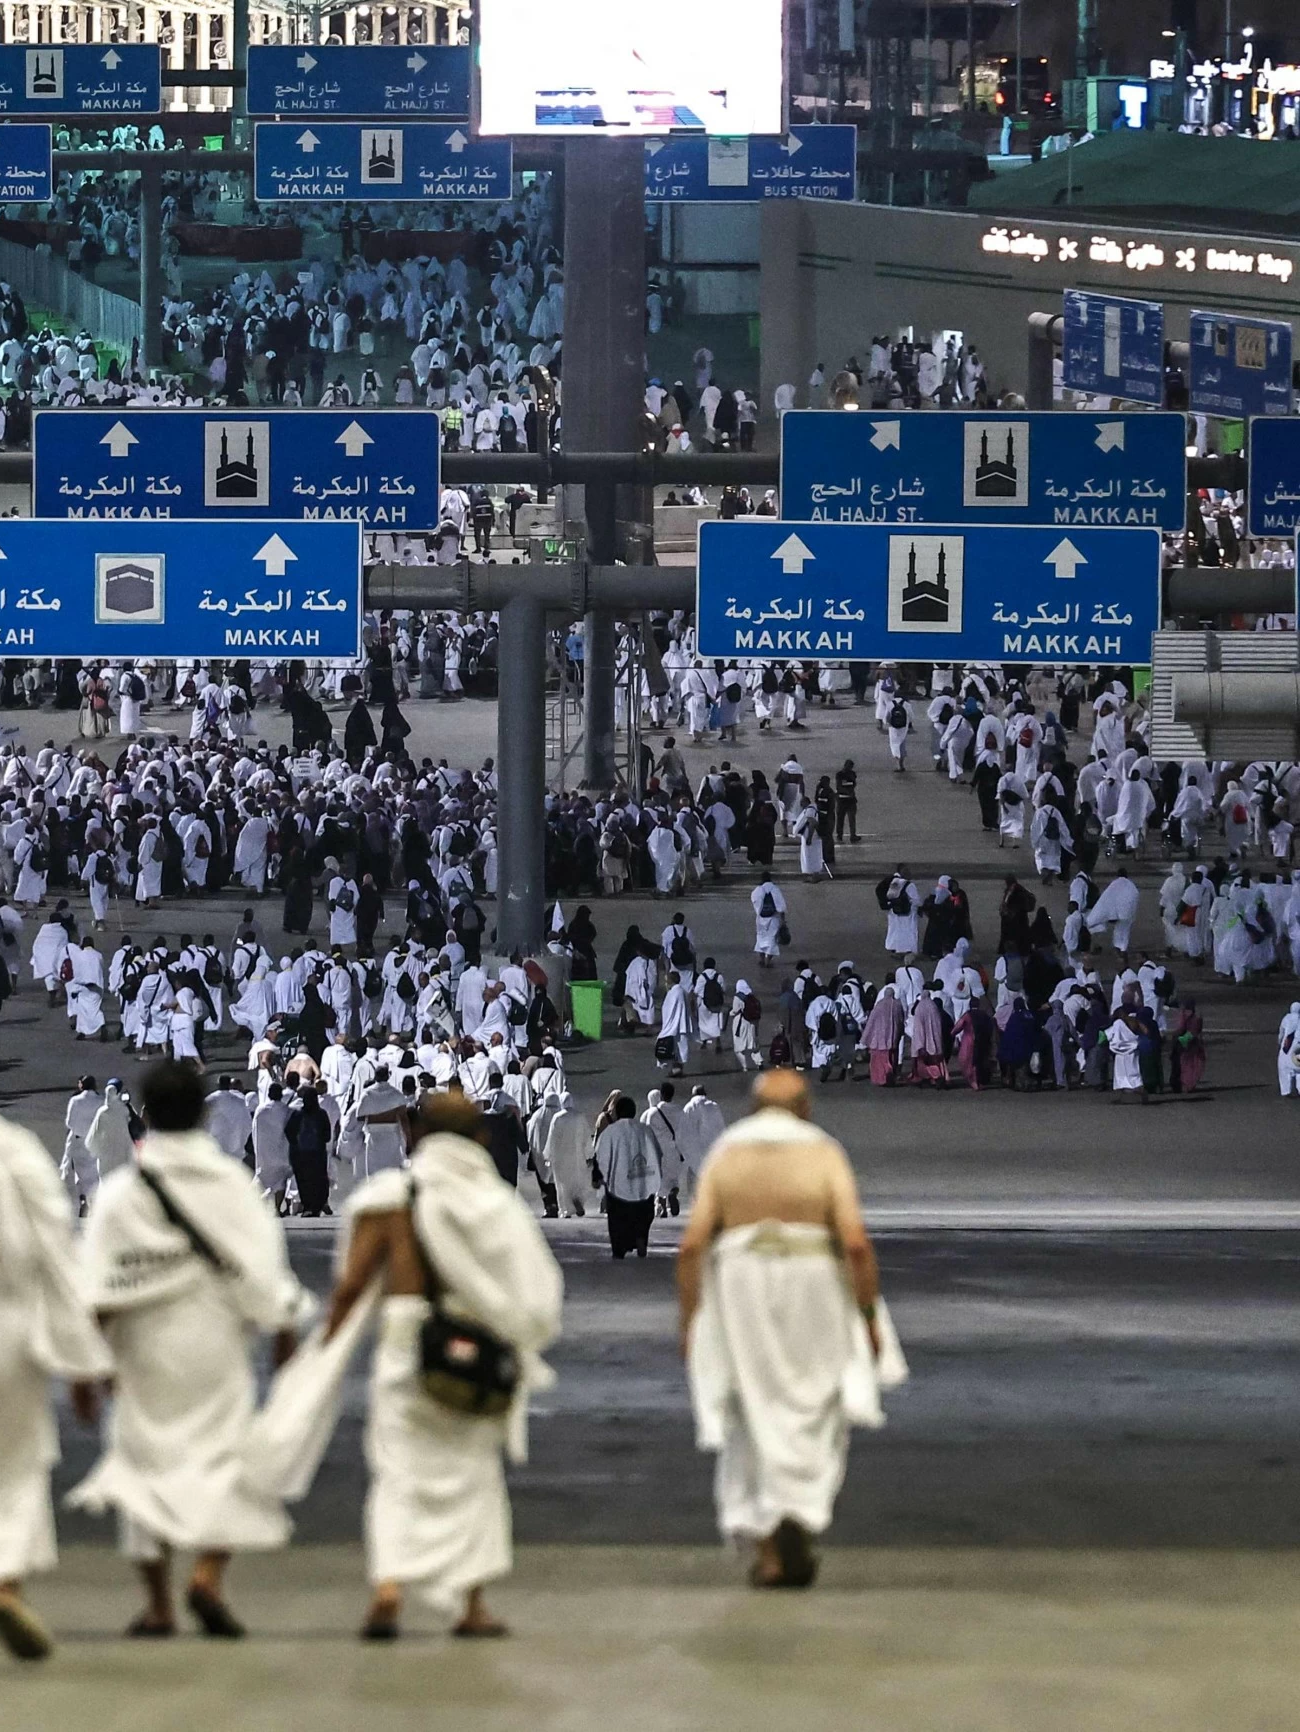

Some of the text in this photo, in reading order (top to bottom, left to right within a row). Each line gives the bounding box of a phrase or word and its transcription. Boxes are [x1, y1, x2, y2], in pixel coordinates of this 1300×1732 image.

[77, 82, 146, 96] مكة المكرمة
[83, 100, 141, 109] MAKKAH
[5, 166, 46, 177] محطة
[271, 166, 348, 180] مكة المكرمة
[419, 167, 497, 180] مكة المكرمة
[655, 163, 689, 181] شارع
[752, 166, 850, 178] محطة حافلات
[279, 184, 343, 194] MAKKAH
[424, 184, 488, 194] MAKKAH
[645, 186, 689, 196] AJJ ST.
[765, 186, 838, 196] BUS STATION
[59, 476, 181, 500] مكة المكرمة
[293, 476, 415, 499] مكة المكرمة
[811, 478, 924, 504] شارع الحج
[1045, 479, 1166, 500] مكة المكرمة
[68, 507, 170, 517] MAKKAH
[303, 507, 406, 522] MAKKAH
[811, 507, 923, 522] AL HAJJ ST.
[1055, 508, 1156, 523] MAKKAH
[16, 589, 60, 610] مكة
[199, 589, 346, 616] مكة المكرمة
[725, 598, 864, 624] مكة المكرمة
[992, 603, 1132, 628] مكة المكرمة
[226, 630, 319, 645] MAKKAH
[736, 630, 852, 650] MAKKAH
[1004, 635, 1120, 654] MAKKAH
